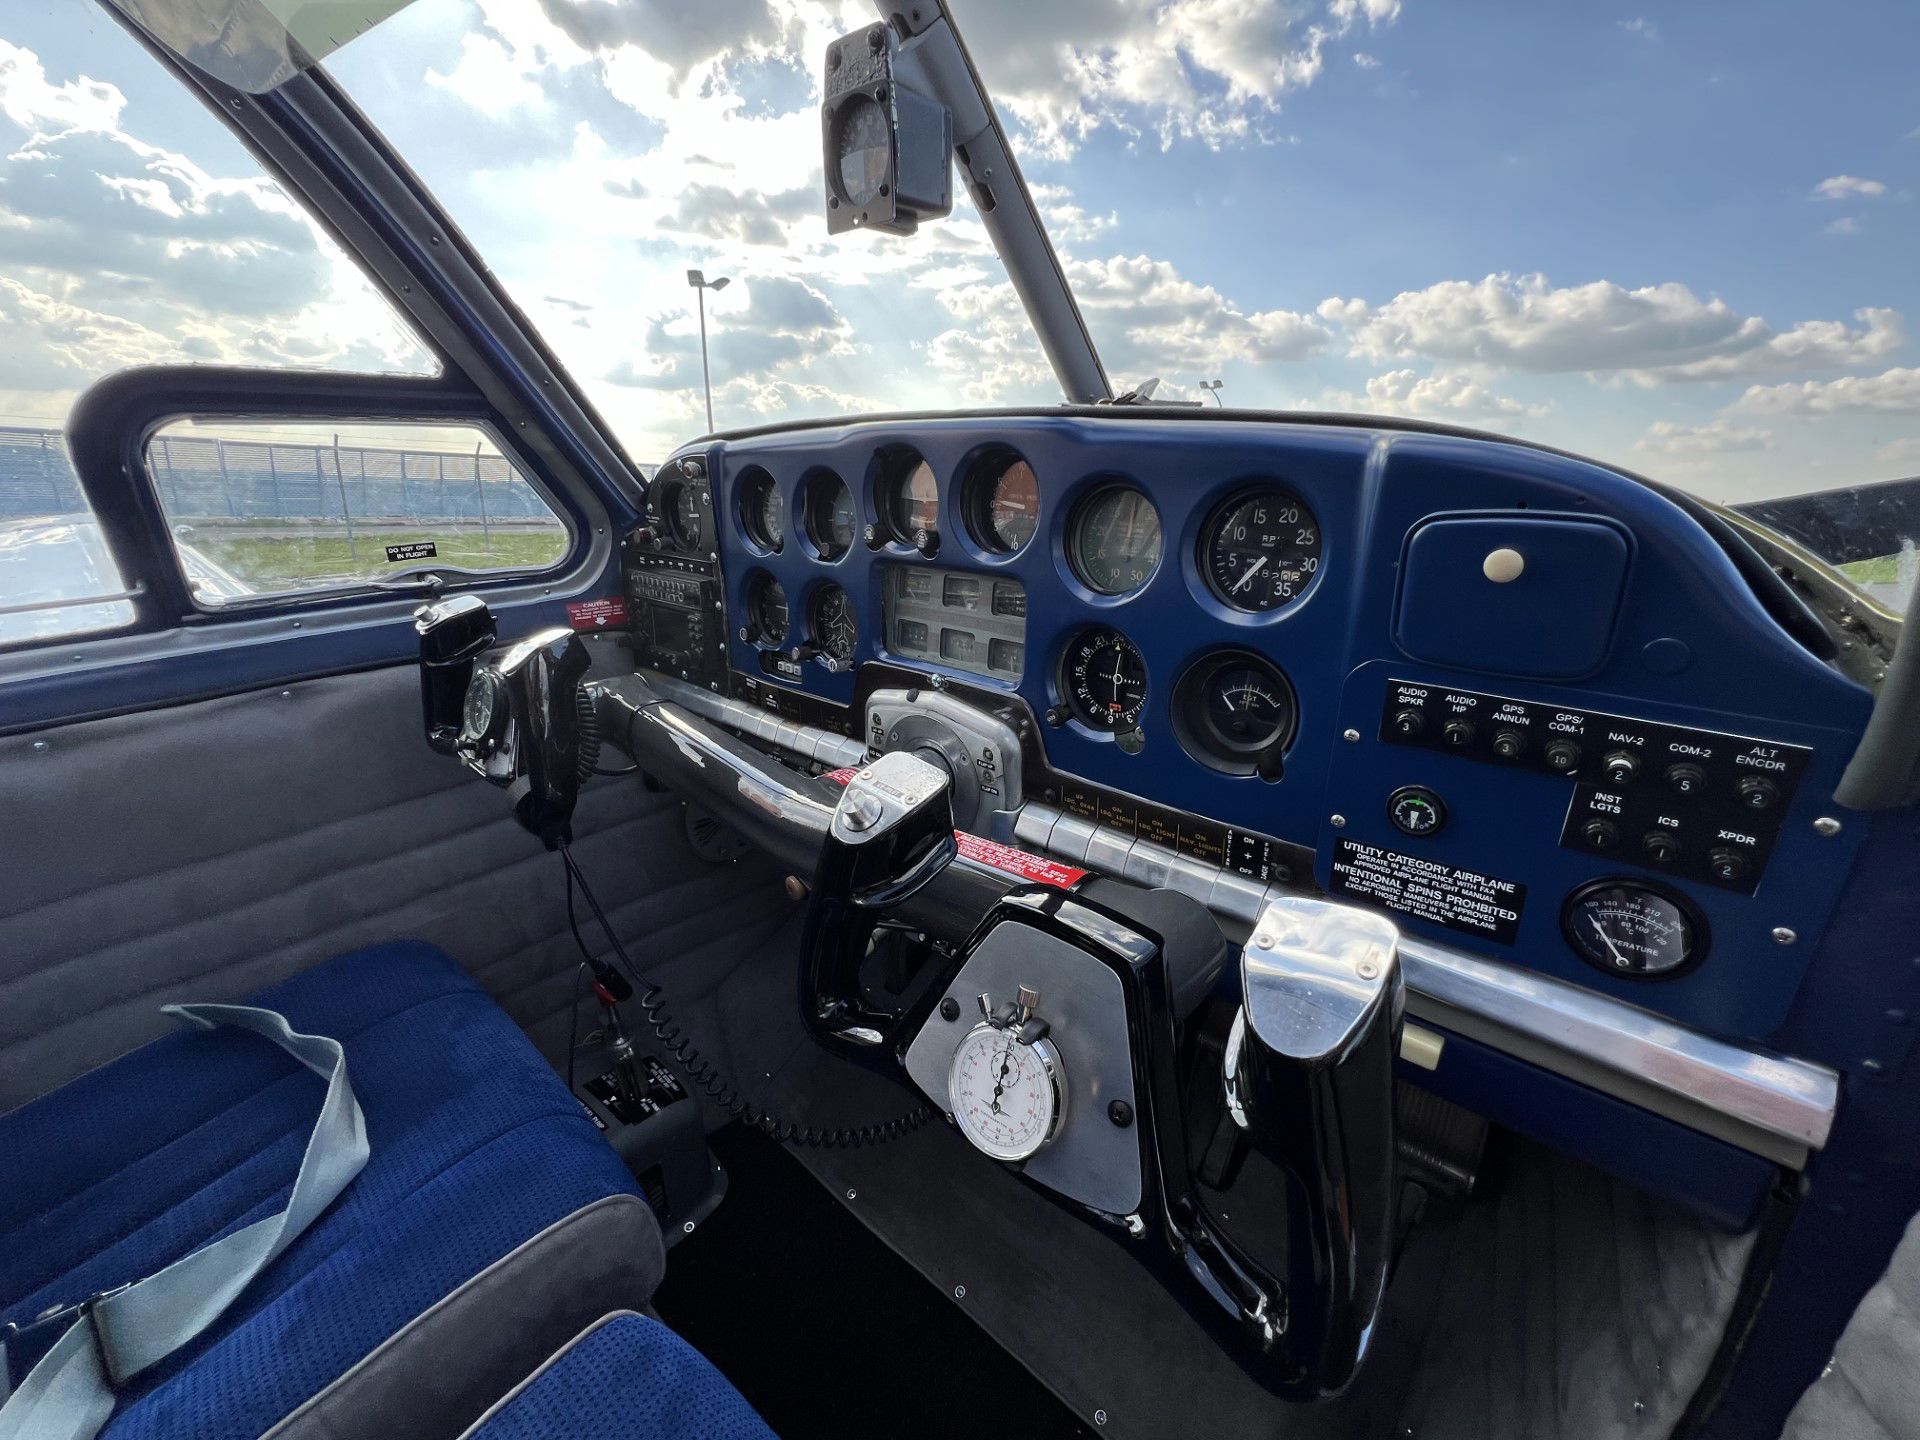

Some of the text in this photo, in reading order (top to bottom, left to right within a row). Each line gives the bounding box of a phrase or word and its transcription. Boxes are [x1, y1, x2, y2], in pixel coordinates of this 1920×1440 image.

[1254, 508, 1298, 524] 15 20
[1234, 526, 1246, 540] 10
[1296, 529, 1314, 545] 25
[1228, 554, 1237, 566] 5
[1300, 558, 1318, 572] 30
[1110, 568, 1120, 578] 10
[1243, 579, 1252, 592] 0
[1274, 582, 1291, 596] 35
[1095, 636, 1105, 646] 21
[1081, 646, 1090, 658] 18
[1075, 666, 1083, 676] 15
[1078, 688, 1087, 698] 12
[1398, 686, 1428, 698] AUDIO
[1398, 696, 1424, 706] SPKR
[1445, 694, 1476, 706] AUDIO
[1452, 705, 1466, 713] HP
[1502, 704, 1524, 714] GPS
[1492, 712, 1530, 726] ANNUN
[1556, 714, 1584, 724] GPS/
[1549, 722, 1584, 734] COM-1
[1608, 732, 1644, 746] NAV-2
[1502, 744, 1509, 752] 3
[1670, 743, 1712, 758] COM-2
[1750, 747, 1778, 758] ALT
[1555, 756, 1566, 764] 10
[1736, 755, 1786, 771] ENCDR
[1615, 770, 1622, 780] 2
[1680, 781, 1690, 791] 5
[1595, 792, 1622, 804] INST
[1752, 794, 1762, 804] 2
[1112, 806, 1122, 814] ON
[1590, 802, 1621, 814] LGTS
[1110, 820, 1122, 828] OFF
[1116, 814, 1134, 825] LIGHT
[1151, 820, 1163, 828] ON
[1658, 816, 1679, 828] ICS
[1150, 833, 1163, 842] OFF
[1156, 828, 1176, 840] LIGHT
[1194, 833, 1207, 843] ON
[1718, 830, 1756, 846] XPDR
[1243, 836, 1254, 846] ON
[1193, 848, 1206, 857] OFF
[1198, 842, 1222, 854] LIGHTS
[1239, 866, 1253, 875] OFF
[1344, 841, 1516, 893] UTILITY CATEGORY AIRPLANE
[1723, 866, 1732, 876] 2
[1049, 870, 1068, 878] SEAT
[1354, 860, 1390, 874] APPROVED
[1393, 870, 1429, 885] AIRPLANE
[1432, 881, 1459, 892] FLIGHT
[1356, 854, 1388, 866] OPERATE
[1401, 866, 1454, 884] ACCORDANCE
[1456, 880, 1476, 890] WITH
[1480, 886, 1495, 895] FAA
[1334, 862, 1517, 920] INTENTIONAL SPINS PROHBITED
[1349, 876, 1494, 922] NO AEROBATIC MANEUVERS APPROVED
[1345, 882, 1372, 894] EXCEPT
[1374, 890, 1398, 902] THOSE
[1401, 898, 1426, 910] LISTED
[1440, 909, 1454, 918] THE
[1458, 914, 1496, 931] AIRPLANE
[1386, 900, 1412, 912] FLIGHT
[1626, 902, 1640, 910] 180
[1644, 907, 1661, 917] 210
[1635, 924, 1650, 934] 100
[1654, 934, 1668, 946] 120
